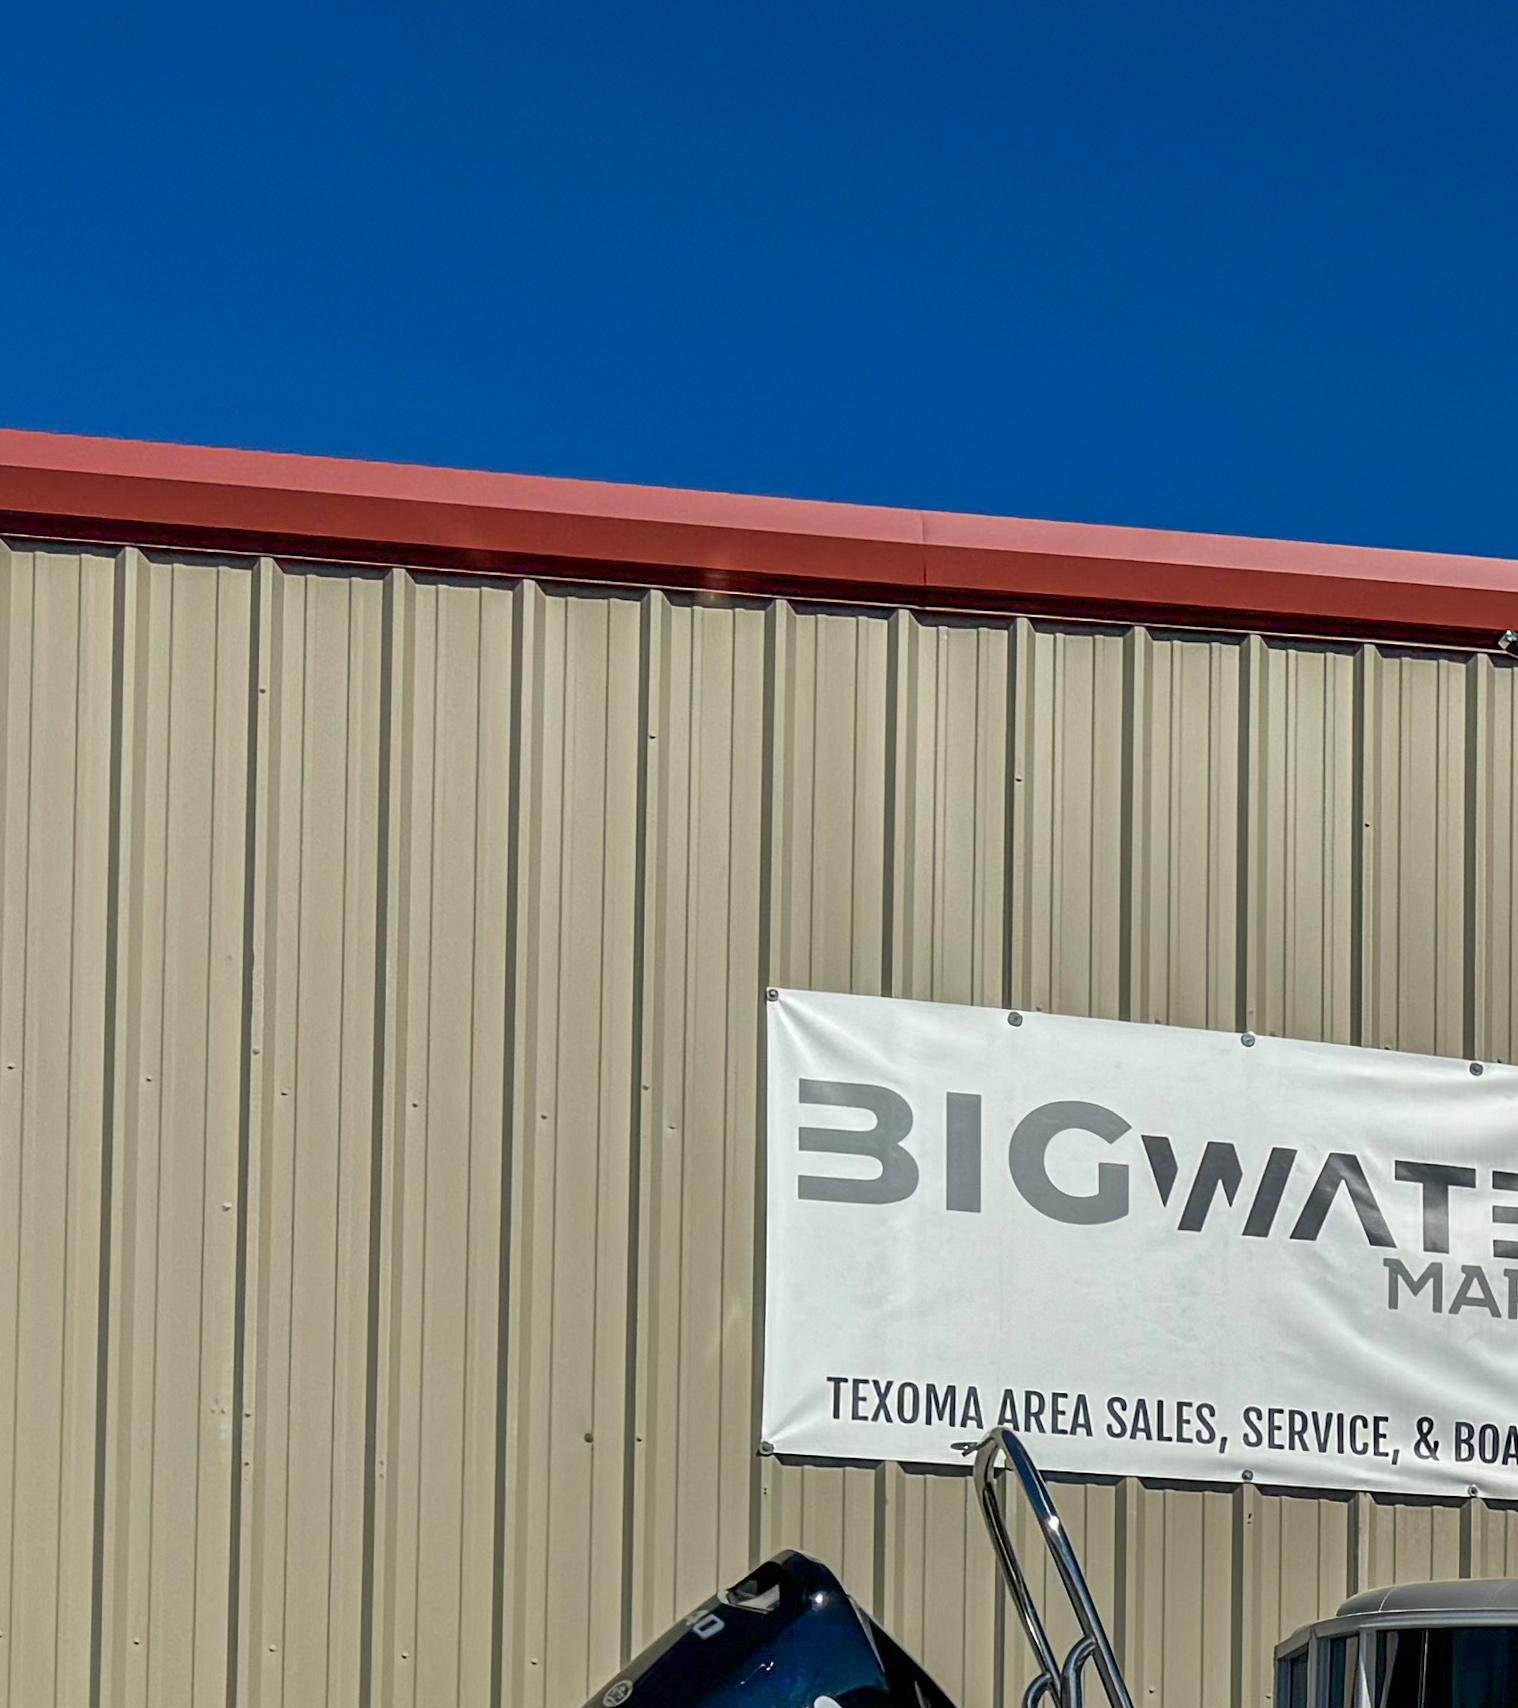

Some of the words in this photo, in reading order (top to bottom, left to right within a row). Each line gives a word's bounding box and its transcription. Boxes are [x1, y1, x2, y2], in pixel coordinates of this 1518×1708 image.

[826, 1376, 983, 1429] TEXOMA
[999, 1388, 1094, 1438] AREA
[1105, 1397, 1228, 1453] SALES,
[1243, 1406, 1400, 1465] SERVICE,
[1413, 1416, 1441, 1461] &
